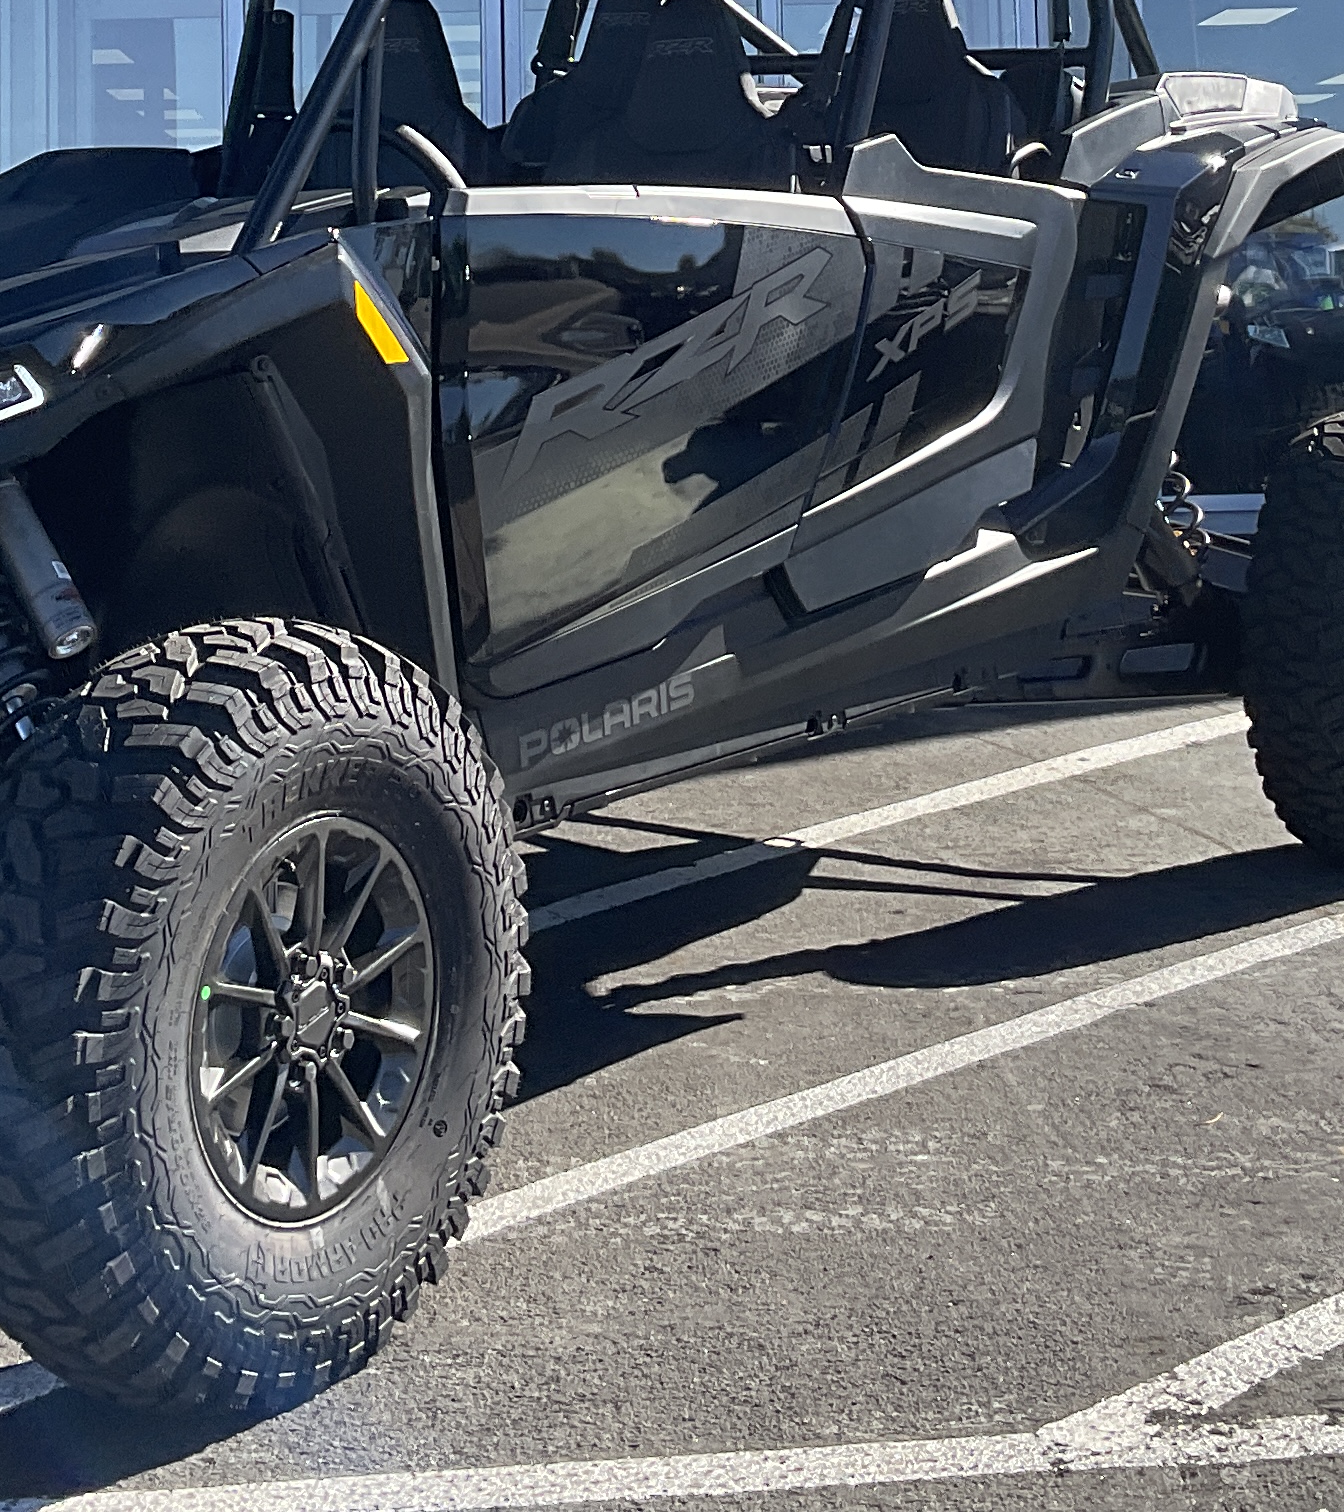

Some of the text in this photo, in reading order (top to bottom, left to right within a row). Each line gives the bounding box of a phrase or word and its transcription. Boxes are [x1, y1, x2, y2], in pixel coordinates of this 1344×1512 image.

[501, 246, 834, 487] RZR
[866, 269, 982, 382] XPS
[518, 672, 696, 769] POLARIS
